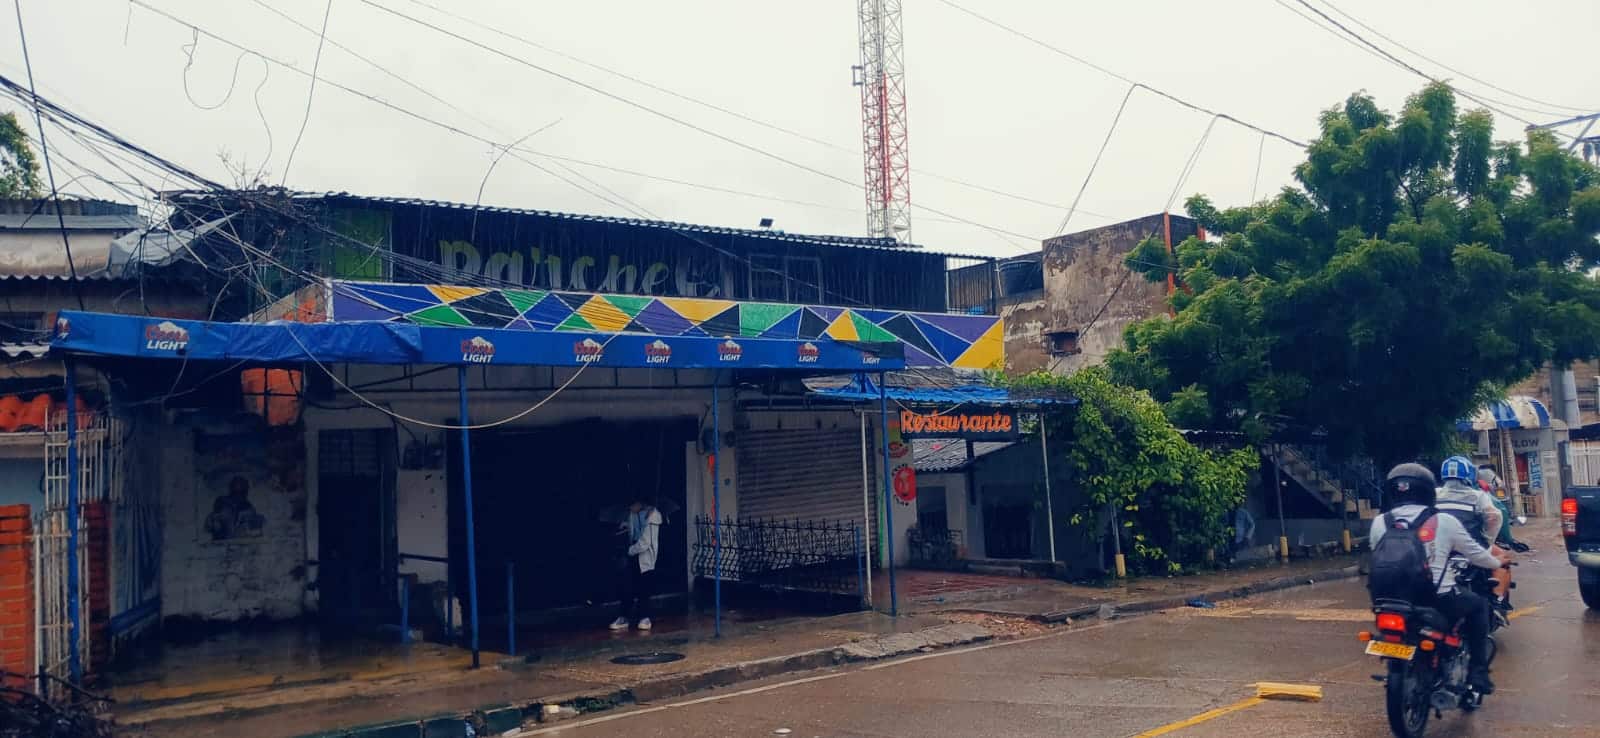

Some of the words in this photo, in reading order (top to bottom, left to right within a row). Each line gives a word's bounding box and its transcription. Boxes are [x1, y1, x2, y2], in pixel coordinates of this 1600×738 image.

[147, 340, 187, 351] LIGHT
[463, 353, 494, 364] LIGHT
[575, 353, 603, 363] LIGHT
[647, 354, 671, 364] LIGHT
[719, 354, 742, 362] LIGHT
[798, 354, 819, 363] LIGHT
[862, 356, 881, 365] LIGHT
[901, 409, 1013, 434] Restaurante
